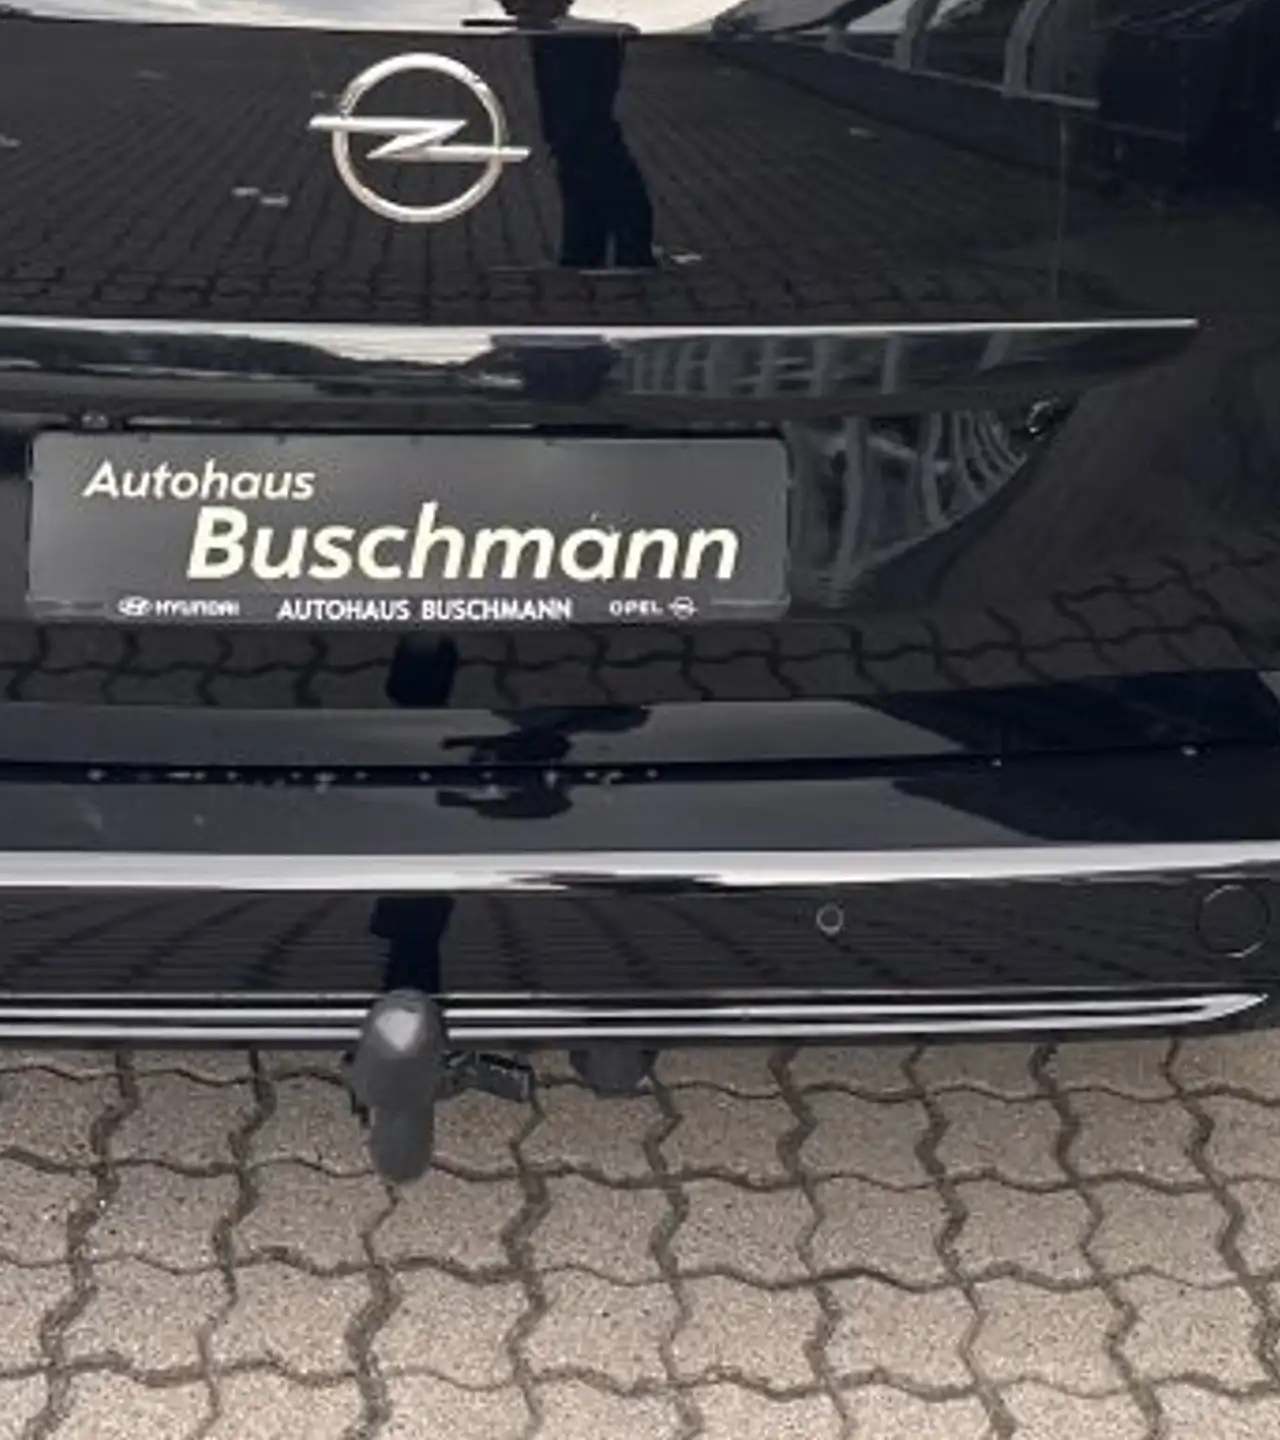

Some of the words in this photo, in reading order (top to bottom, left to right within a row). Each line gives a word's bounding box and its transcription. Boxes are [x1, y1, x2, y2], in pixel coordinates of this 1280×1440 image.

[83, 459, 317, 501] Autohaus
[186, 500, 740, 581] Buschmann
[276, 598, 410, 622] AUTOHAUS
[421, 598, 574, 623] BUSCHMANN
[609, 599, 663, 617] OPEL
